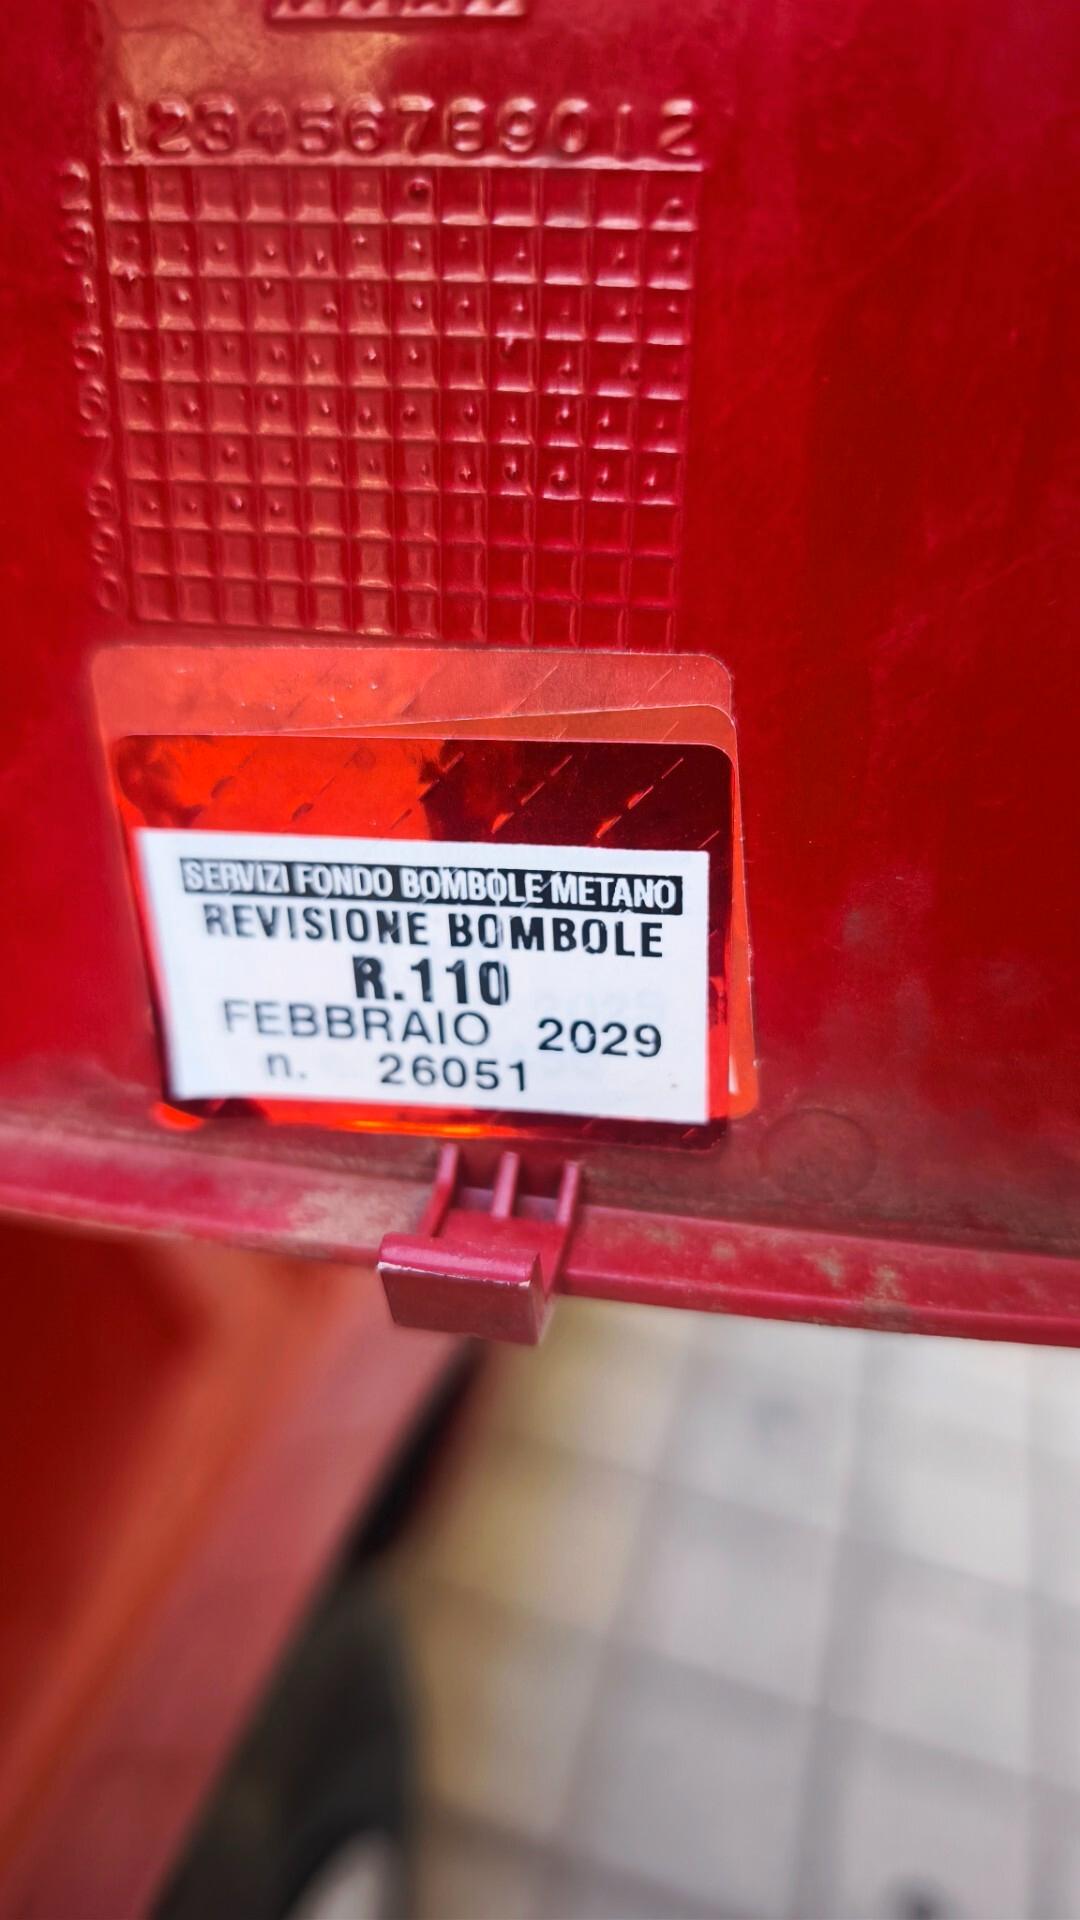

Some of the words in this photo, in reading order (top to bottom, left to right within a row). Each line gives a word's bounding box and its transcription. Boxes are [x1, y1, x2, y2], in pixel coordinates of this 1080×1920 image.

[182, 861, 292, 895] SERVIZI
[297, 864, 394, 899] FONDO
[400, 868, 545, 908] BOMBOLE
[549, 875, 678, 913] METANO
[205, 905, 431, 946] REVISIONE
[448, 913, 664, 959] BOMBOLE
[352, 955, 511, 1007] R.110
[223, 1000, 491, 1047] FEBBRAIO
[537, 1017, 662, 1059] 2029
[266, 1053, 308, 1082] n.
[378, 1053, 528, 1093] 26051
